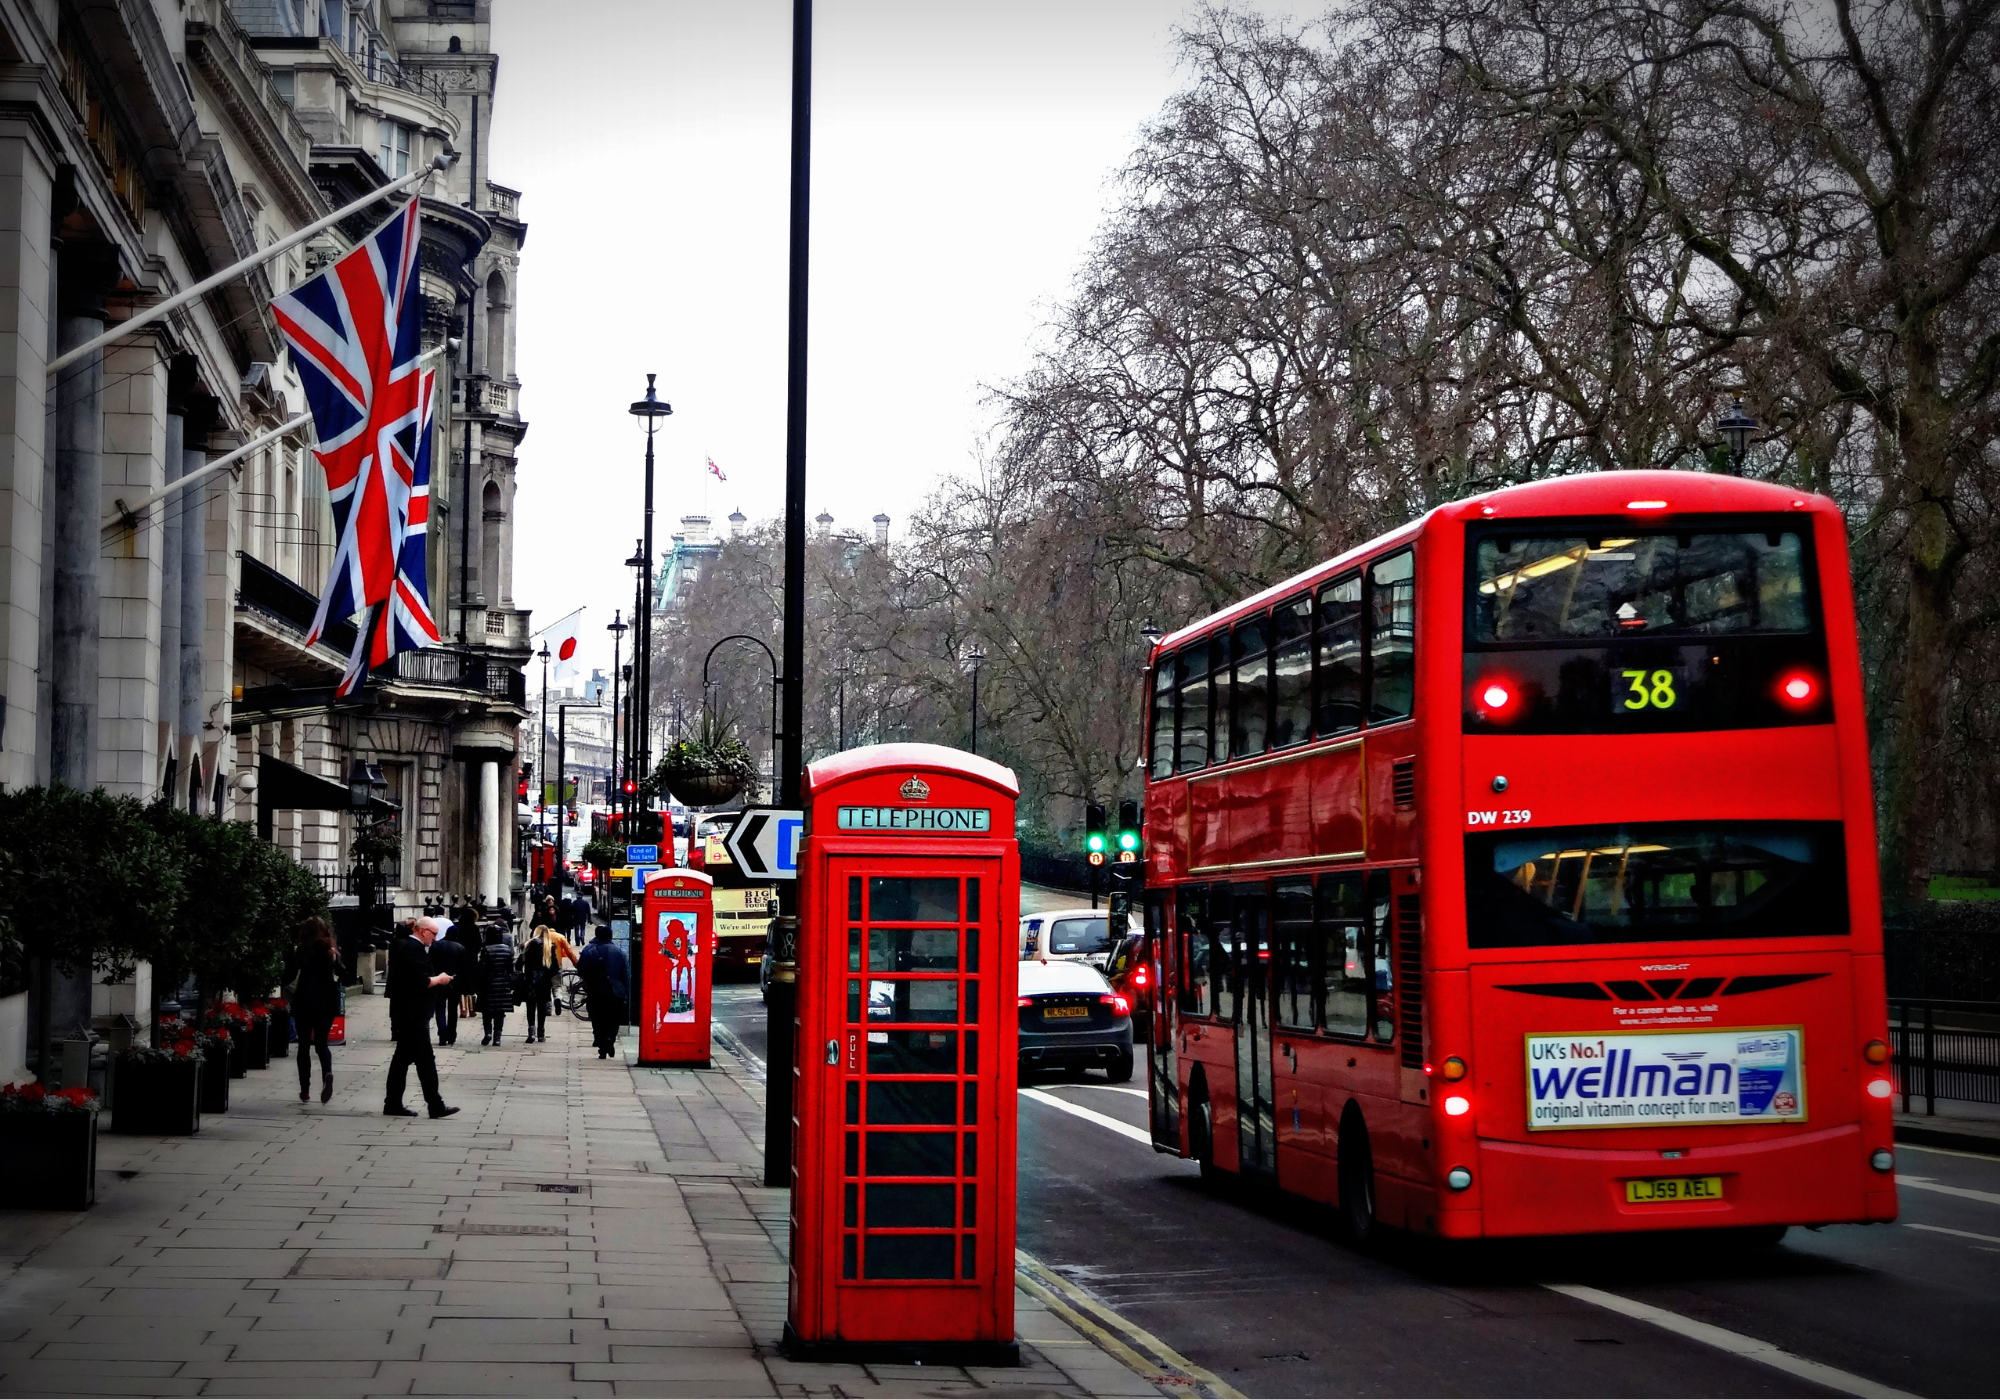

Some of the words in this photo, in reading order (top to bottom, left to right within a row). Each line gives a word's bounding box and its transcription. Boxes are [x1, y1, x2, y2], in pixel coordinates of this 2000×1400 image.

[1622, 669, 1676, 710] 38
[843, 808, 984, 829] TELEPHONE
[1467, 810, 1498, 825] DW
[1502, 809, 1532, 824] 239
[744, 890, 769, 898] BIG
[1613, 1007, 1627, 1015] For
[1666, 1005, 1684, 1013] with
[1532, 1043, 1567, 1060] UK's
[1570, 1040, 1605, 1059] No.1
[1532, 1049, 1732, 1100] wellman
[1535, 1101, 1584, 1122] original
[1586, 1100, 1635, 1118] vitamin
[1638, 1101, 1685, 1119] concept
[1688, 1098, 1706, 1115] for
[1708, 1100, 1736, 1114] men
[1633, 1182, 1677, 1200] LJ59
[1683, 1180, 1715, 1197] AEL
